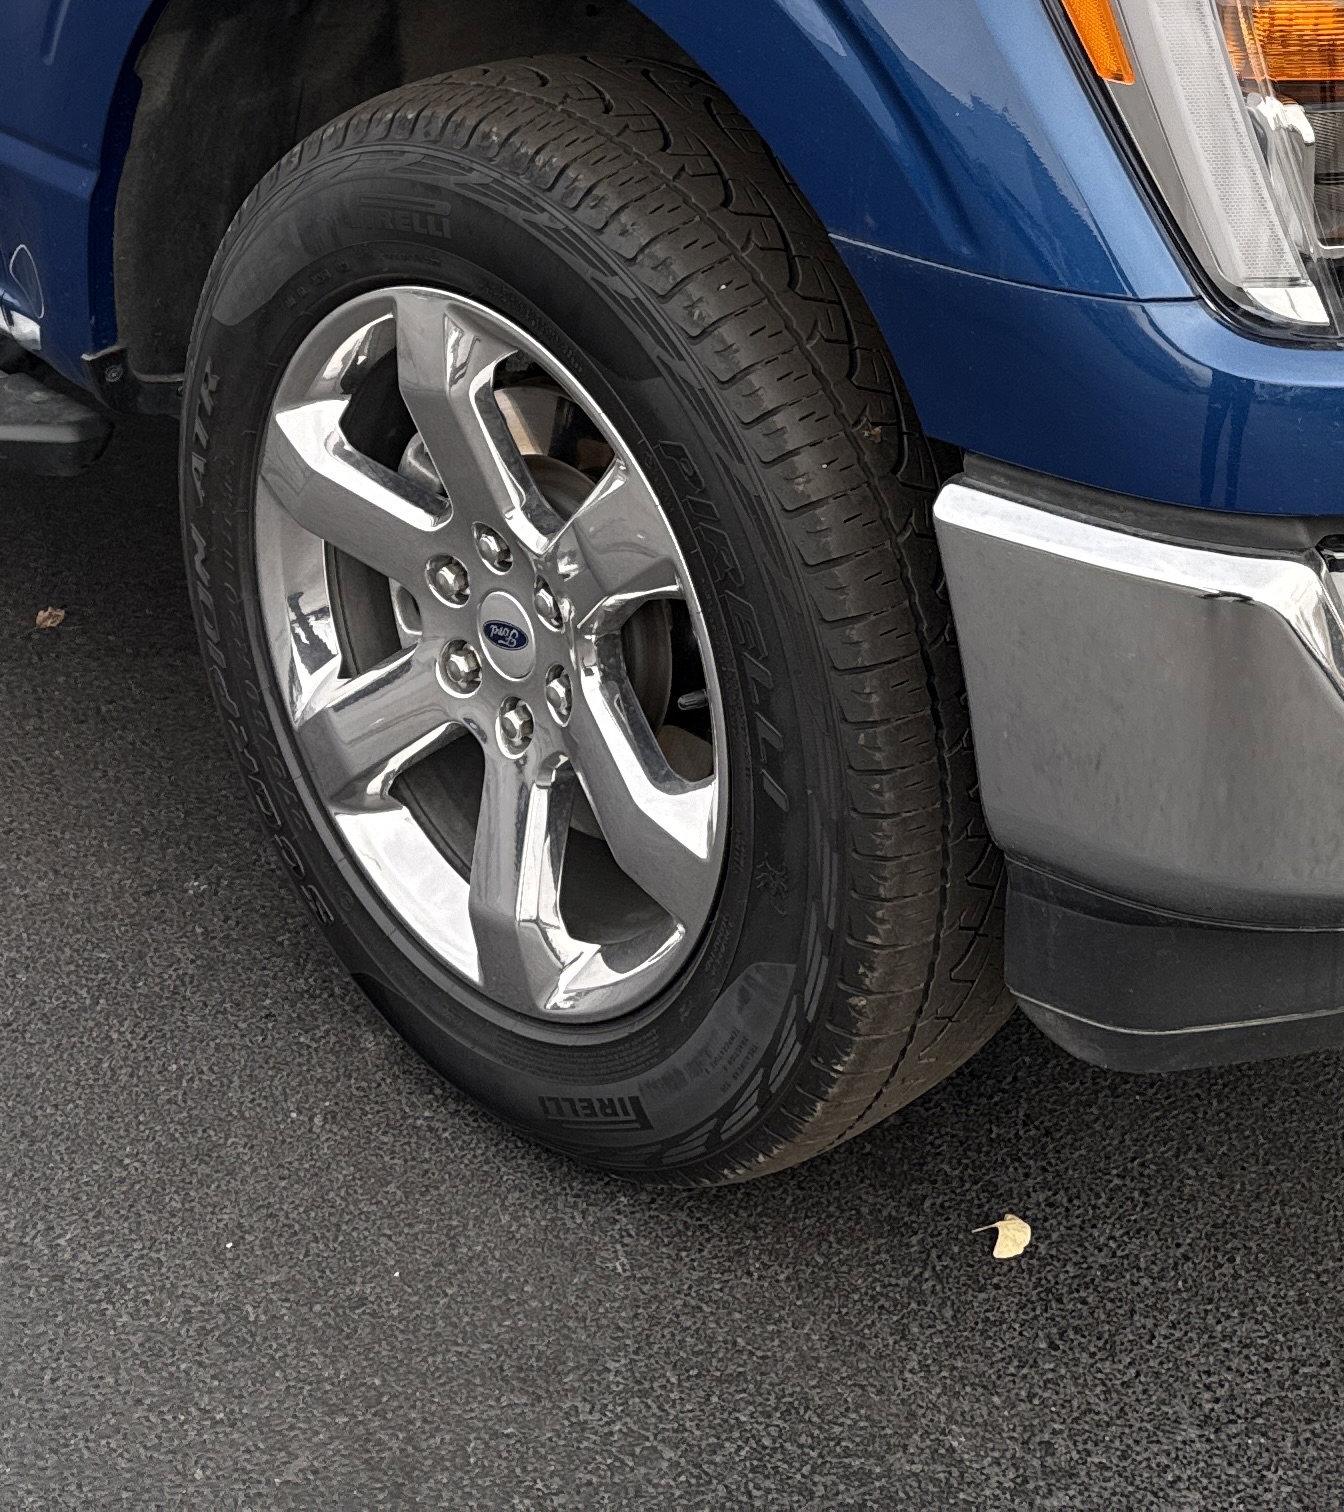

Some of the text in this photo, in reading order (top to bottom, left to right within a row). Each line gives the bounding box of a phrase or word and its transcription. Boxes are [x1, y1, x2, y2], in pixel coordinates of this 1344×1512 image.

[190, 356, 219, 503] ATR
[490, 625, 519, 647] Ford
[659, 442, 788, 810] PIRELLI
[539, 1096, 653, 1130] PIRELLI
